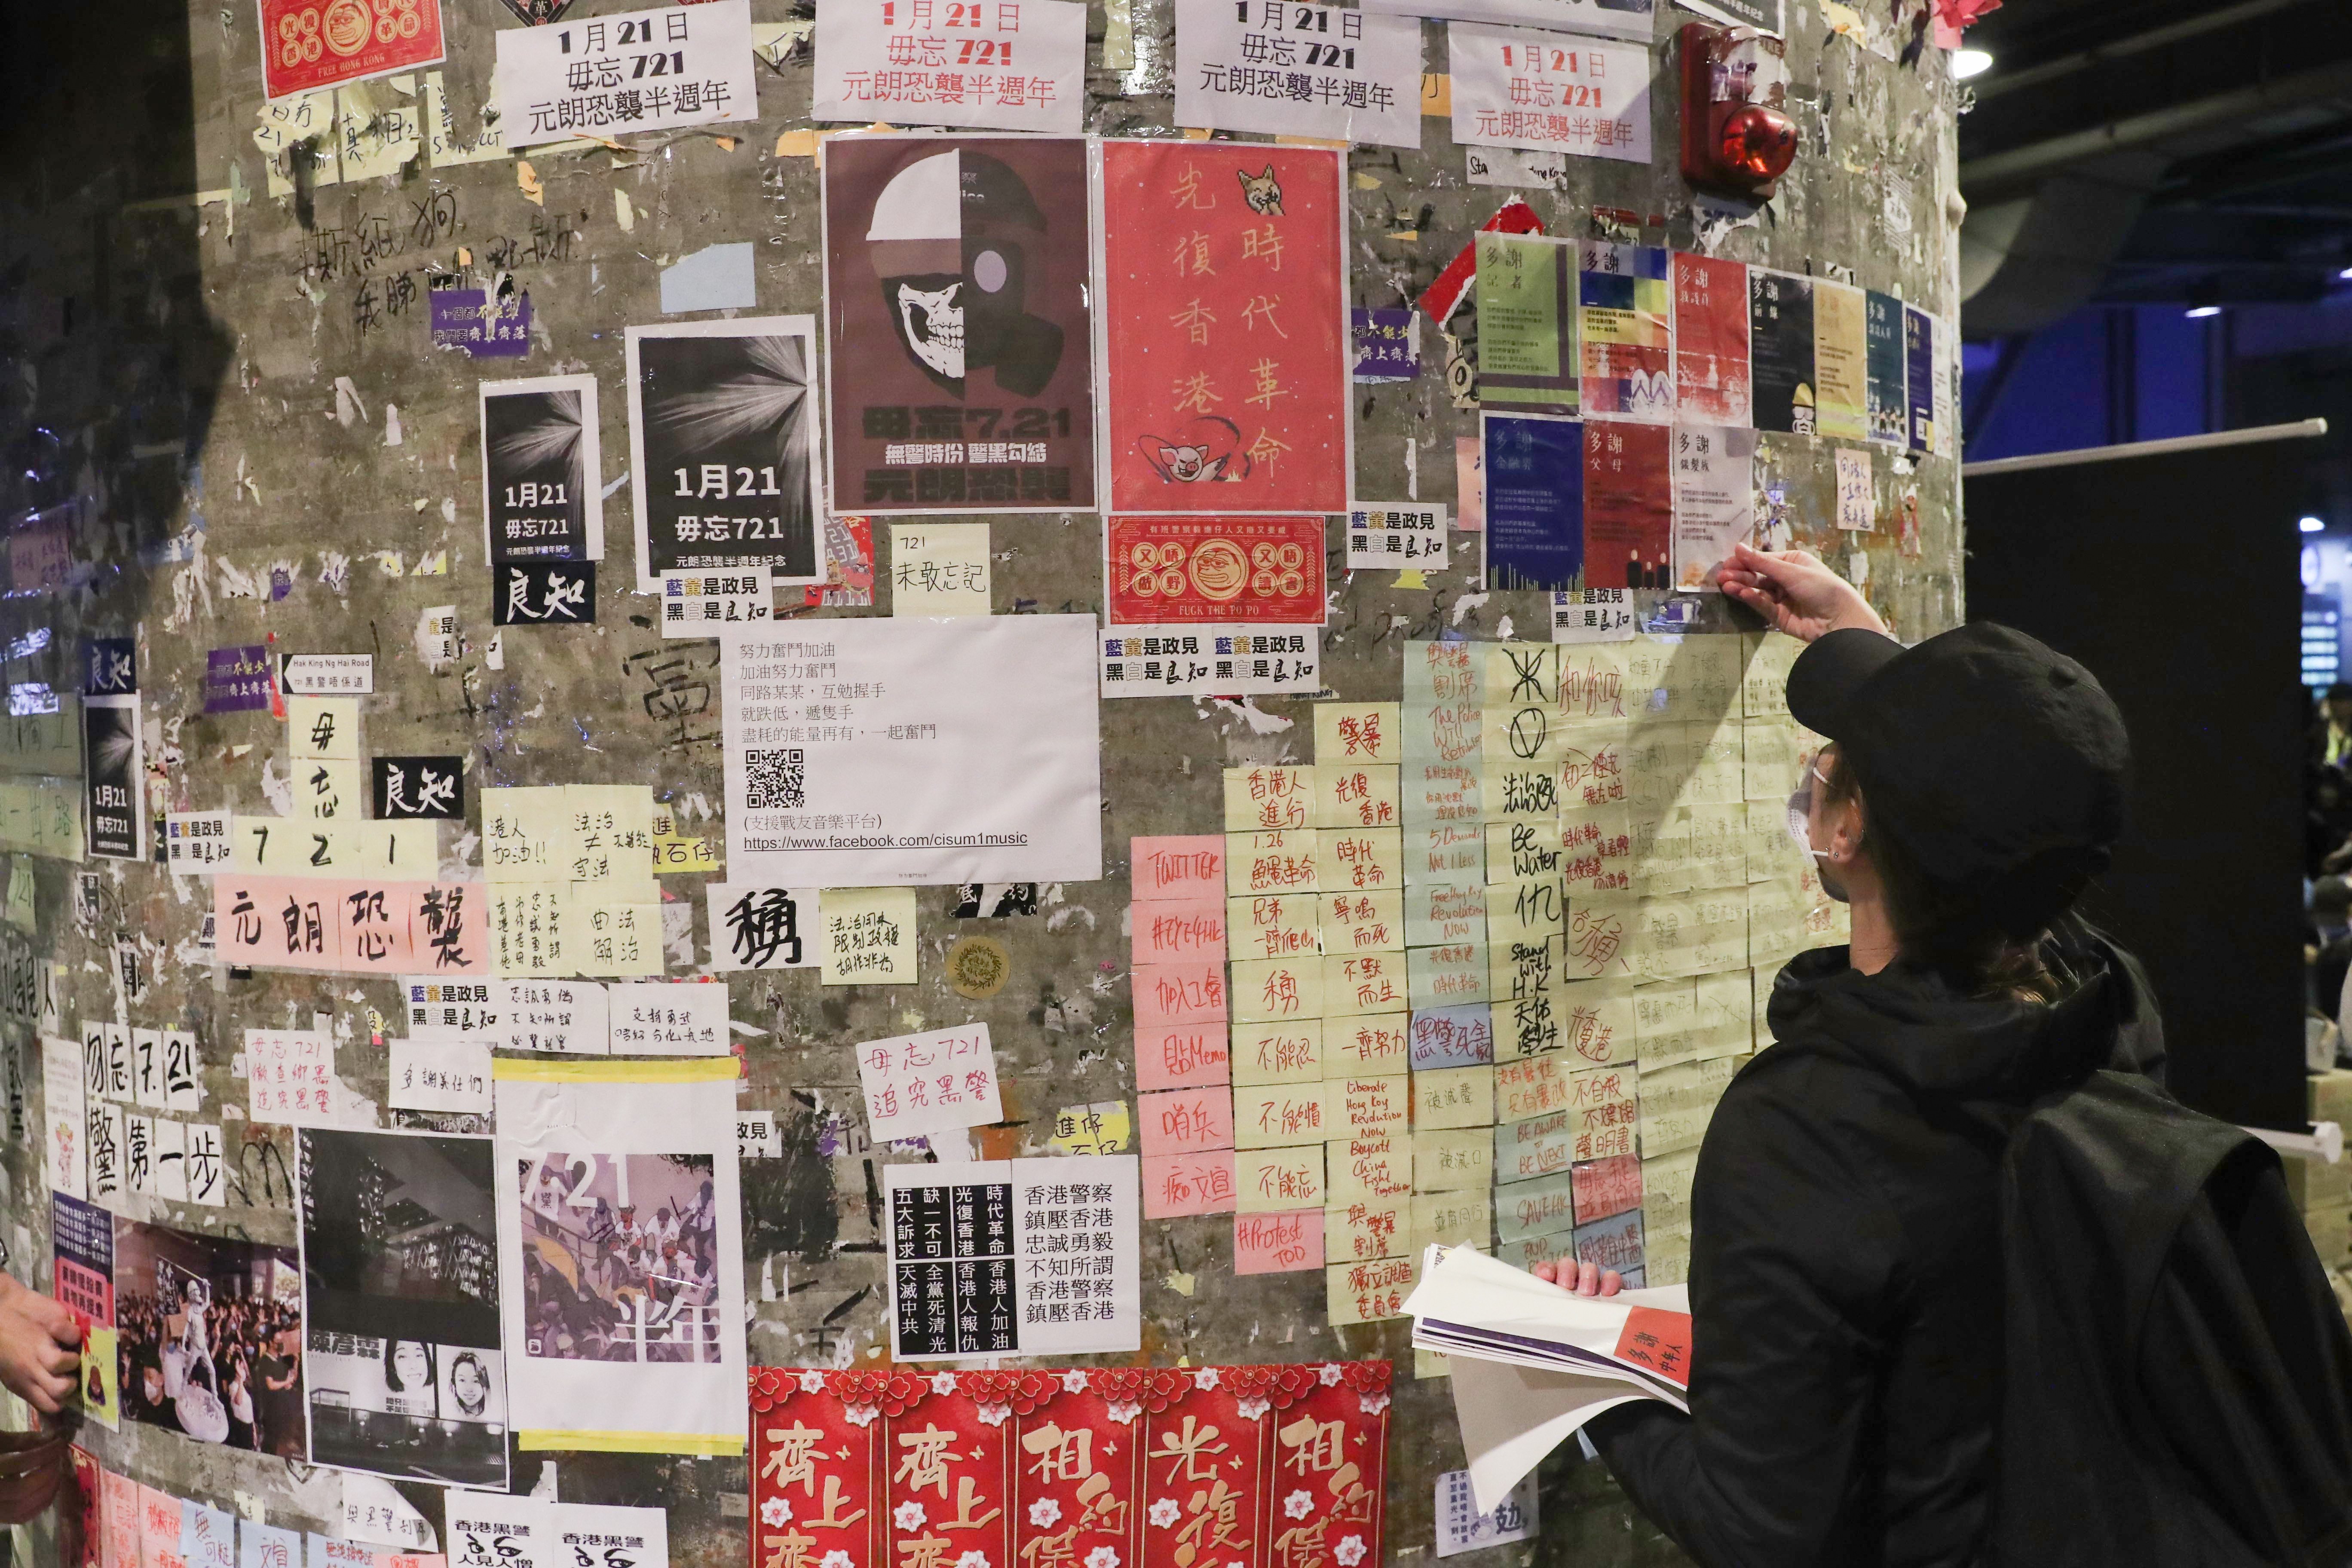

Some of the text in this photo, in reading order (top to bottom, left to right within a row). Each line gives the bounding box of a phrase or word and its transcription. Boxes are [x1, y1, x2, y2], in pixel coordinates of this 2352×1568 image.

[842, 70, 1057, 108] 元朗恐襲半週年
[1200, 62, 1394, 113] 元朗恐襲半週年
[529, 80, 732, 135] 元朗恐襲半週年
[1476, 109, 1634, 148] 元朗恐襲半週年
[1486, 246, 1522, 269] 多謝
[1586, 251, 1619, 273] 多謝
[1680, 264, 1709, 288] 多謝
[1754, 281, 1779, 302] 多謝
[968, 443, 1047, 465] 警黑勾結
[1591, 432, 1623, 454] 多謝
[1679, 432, 1710, 454] 多謝
[1591, 457, 1622, 472] 父母
[674, 464, 781, 500] 1月21
[505, 482, 567, 508] 1月21
[505, 519, 569, 539] 毋忘721
[675, 515, 784, 542] 毋忘721
[1352, 511, 1435, 530] 藍黃是政見
[899, 536, 926, 550] 721
[1352, 535, 1442, 558] 黑白是良知
[676, 554, 787, 569] 元朗恐襲半週年紀念
[666, 576, 758, 597] 藍黃是政見
[896, 561, 986, 593] 未敢忘記
[1555, 588, 1623, 605] 藍黃是政見
[667, 600, 768, 622] 黑白是良知
[1179, 605, 1259, 616] FUCK THE PO PO
[1556, 609, 1630, 631] 黑白是良知
[739, 642, 836, 659] 努力奮鬥加油
[1106, 637, 1199, 657] 藍黃是政見
[1215, 636, 1305, 655] 藍黃是政見
[294, 658, 370, 669] Hak King Ng Hai Road
[740, 663, 836, 680] 加油努力奮鬥
[1106, 660, 1208, 684] 黑白是良知
[1216, 658, 1314, 683] 黑白是良知
[1247, 769, 1306, 800] 香港人
[95, 785, 127, 808] 1月21
[170, 821, 224, 838] 藍黃是政見
[171, 842, 230, 863] 黑白是良知
[744, 831, 1028, 852] https://www.facebook.com/cisum1music
[231, 885, 473, 970] 元朗恐襲
[410, 985, 488, 1003] 藍黃是政見
[413, 1008, 497, 1031] 黑白是良知
[873, 1071, 990, 1118] 追究黑警
[1025, 1183, 1113, 1205] 香港警察
[897, 1188, 915, 1259] 五大訴求
[922, 1187, 942, 1258] 缺一不可
[956, 1187, 974, 1257] 光復香港
[986, 1185, 1005, 1255] 時代革命
[1025, 1207, 1114, 1230] 鎮壓香港
[1025, 1232, 1114, 1254] 忠誠勇毅
[1025, 1256, 1114, 1277] 不知所謂
[899, 1265, 919, 1334] 天滅中共
[1026, 1278, 1114, 1301] 香港警察
[925, 1264, 946, 1353] 全黨死清光
[958, 1263, 979, 1351] 香港人報仇
[988, 1261, 1009, 1349] 香港人加油
[1026, 1302, 1115, 1324] 鎮壓香港
